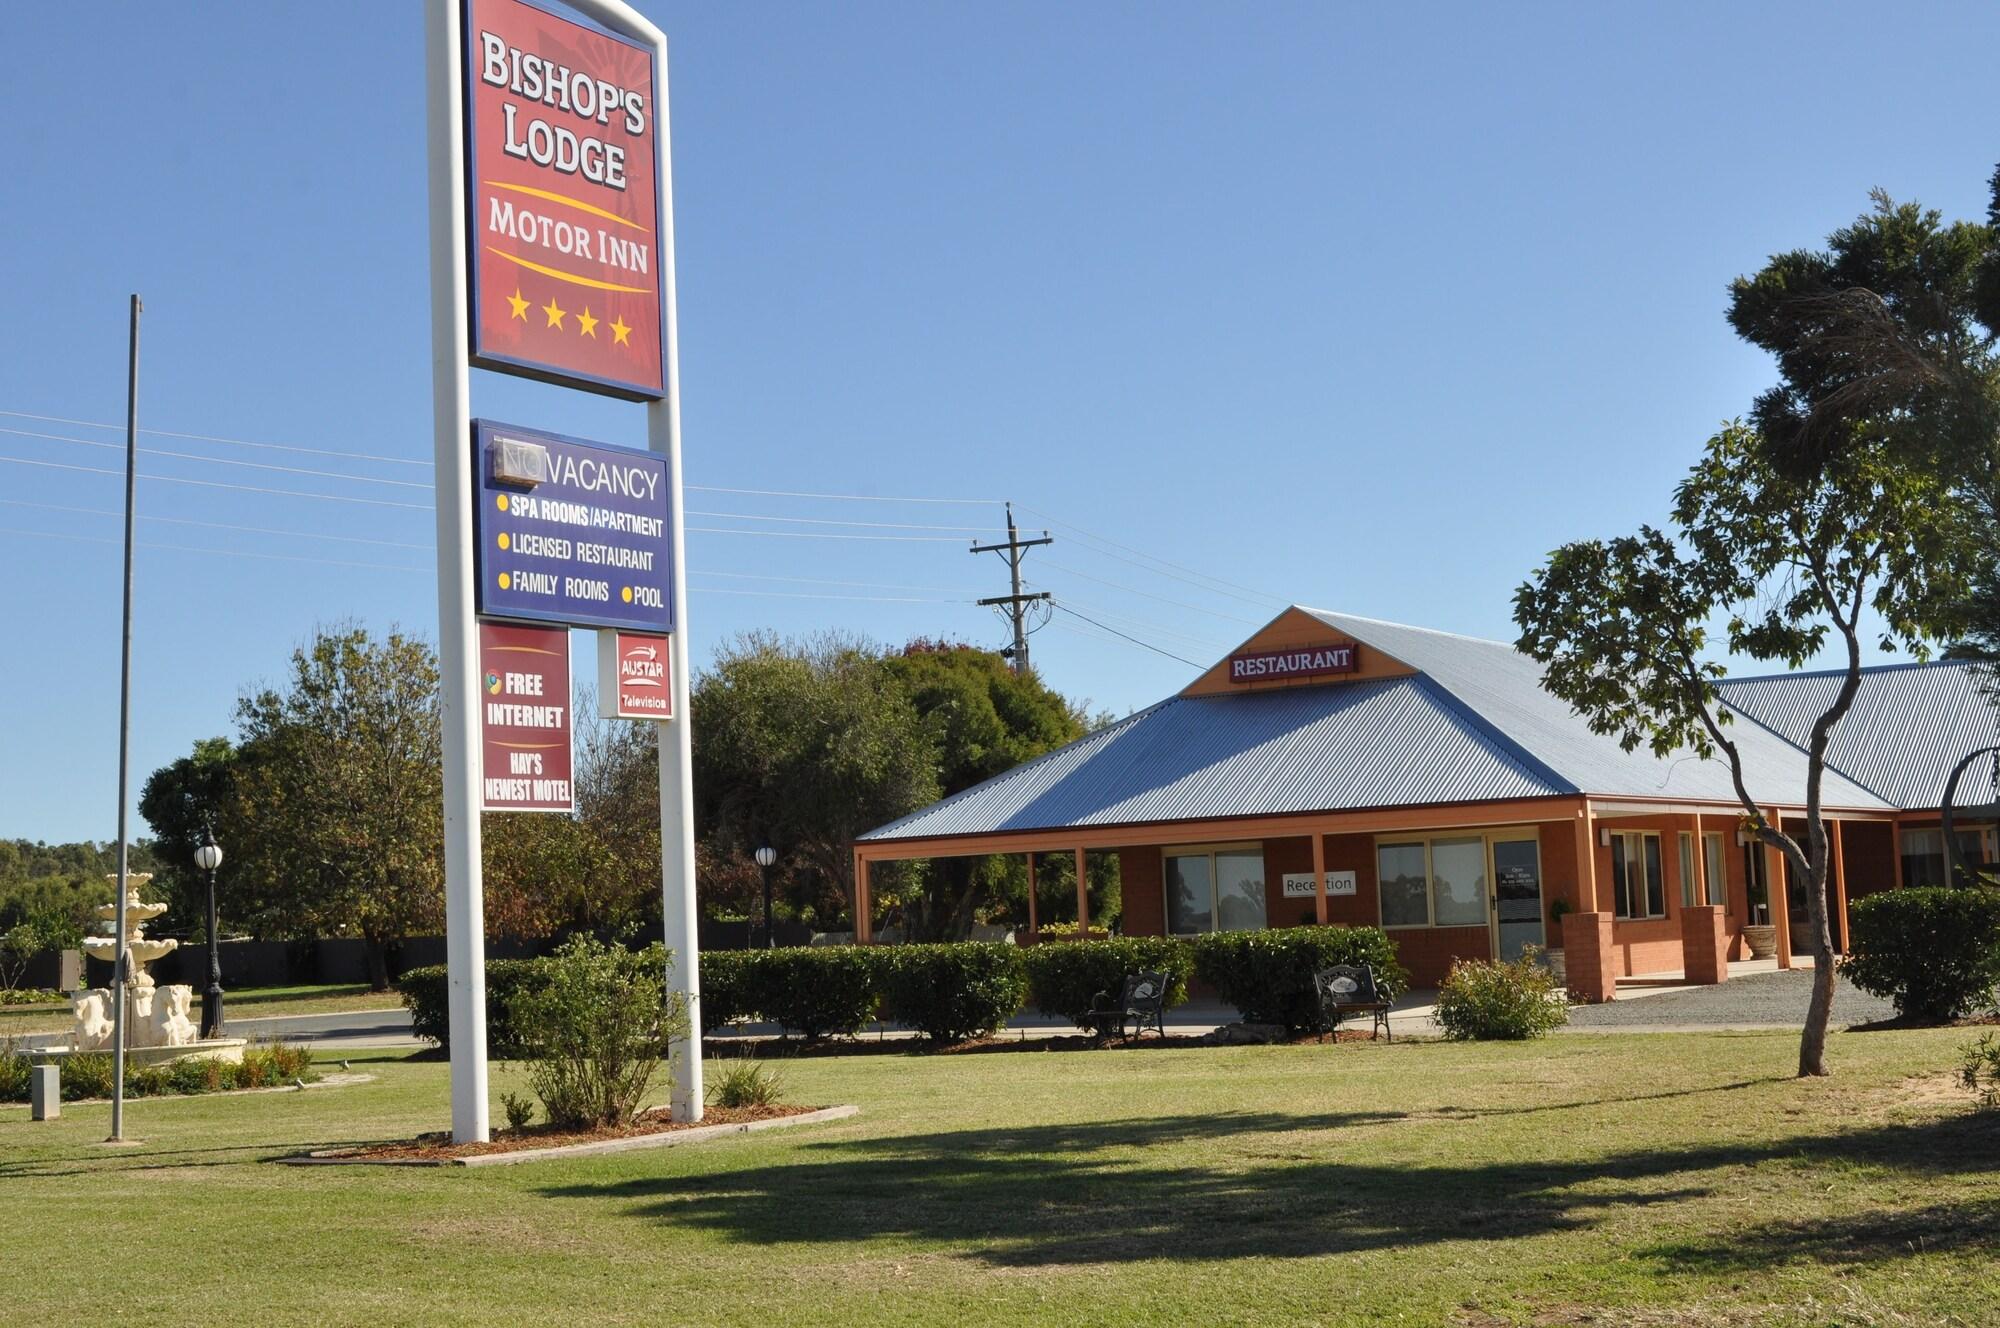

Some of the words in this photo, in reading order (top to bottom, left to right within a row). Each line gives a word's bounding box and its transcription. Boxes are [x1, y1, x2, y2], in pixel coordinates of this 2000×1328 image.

[481, 31, 646, 136] BISHOP'S
[502, 103, 627, 191] LODGE
[489, 197, 592, 260] MOTOR
[598, 230, 649, 275] INN
[545, 452, 659, 501] VACANCY
[511, 495, 539, 520] SPA
[541, 500, 664, 538] ROOMS/APARTMENT
[512, 532, 571, 560] LICENSED
[576, 542, 654, 571] RESTAURANT
[512, 570, 558, 595] FAMILY
[565, 577, 609, 602] ROOMS
[634, 586, 664, 609] POOL
[622, 660, 664, 677] AUSTAR
[1233, 649, 1350, 677] RESTAURANT
[505, 672, 544, 696] FREE
[622, 694, 667, 709] Television
[487, 703, 564, 729] INTERNET
[510, 752, 543, 776] HAY'S
[485, 778, 532, 801] NEWEST
[533, 779, 571, 802] MOTEL
[1286, 876, 1352, 892] Recetion
